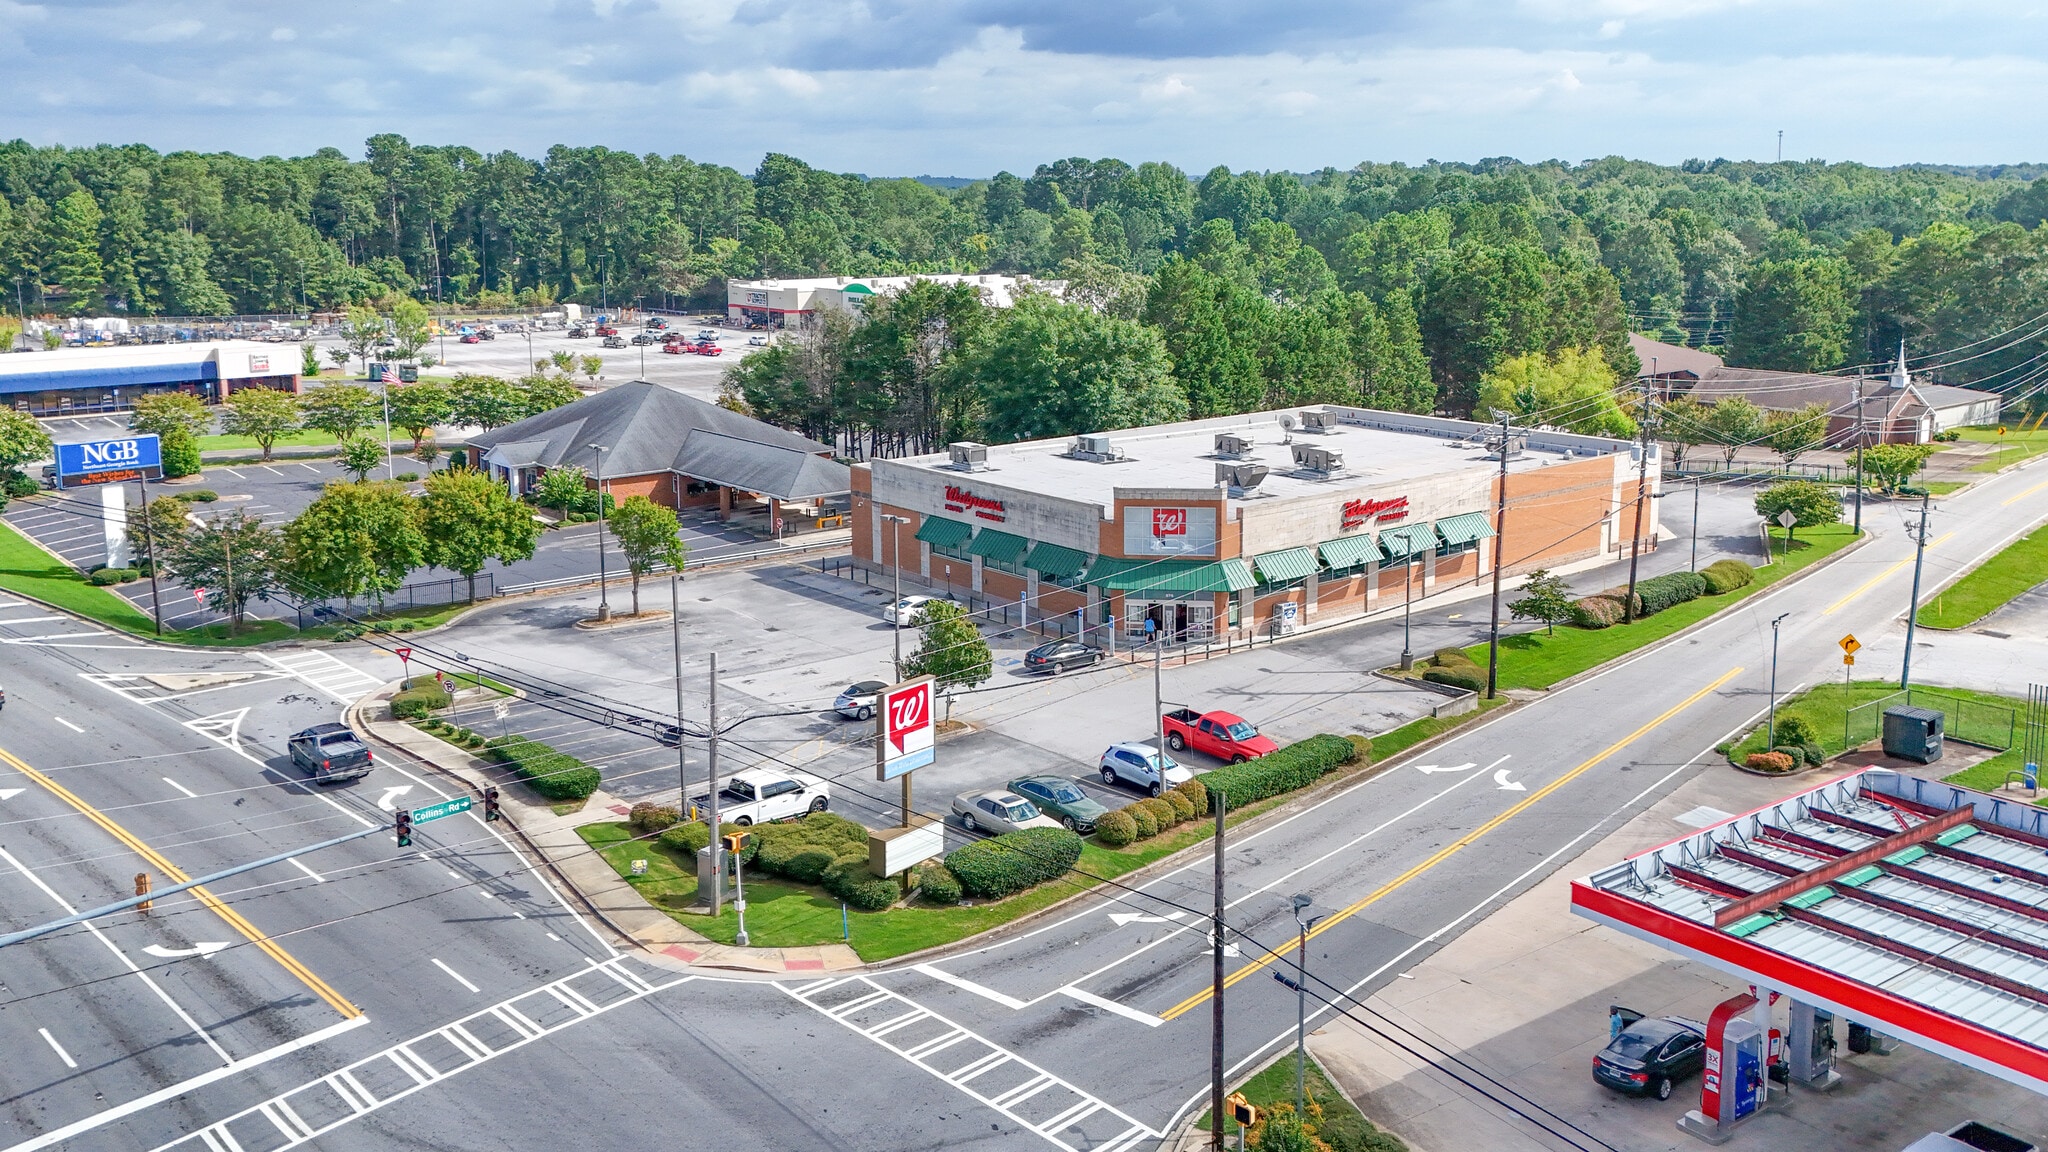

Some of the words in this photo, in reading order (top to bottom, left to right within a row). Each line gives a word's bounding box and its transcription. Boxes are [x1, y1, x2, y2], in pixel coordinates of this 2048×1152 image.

[80, 440, 139, 464] NGB
[944, 485, 1005, 512] Walgreens
[1345, 495, 1409, 519] Walgreens
[414, 808, 444, 822] Collins
[448, 802, 460, 812] Rd
[1707, 1053, 1718, 1064] 3X
